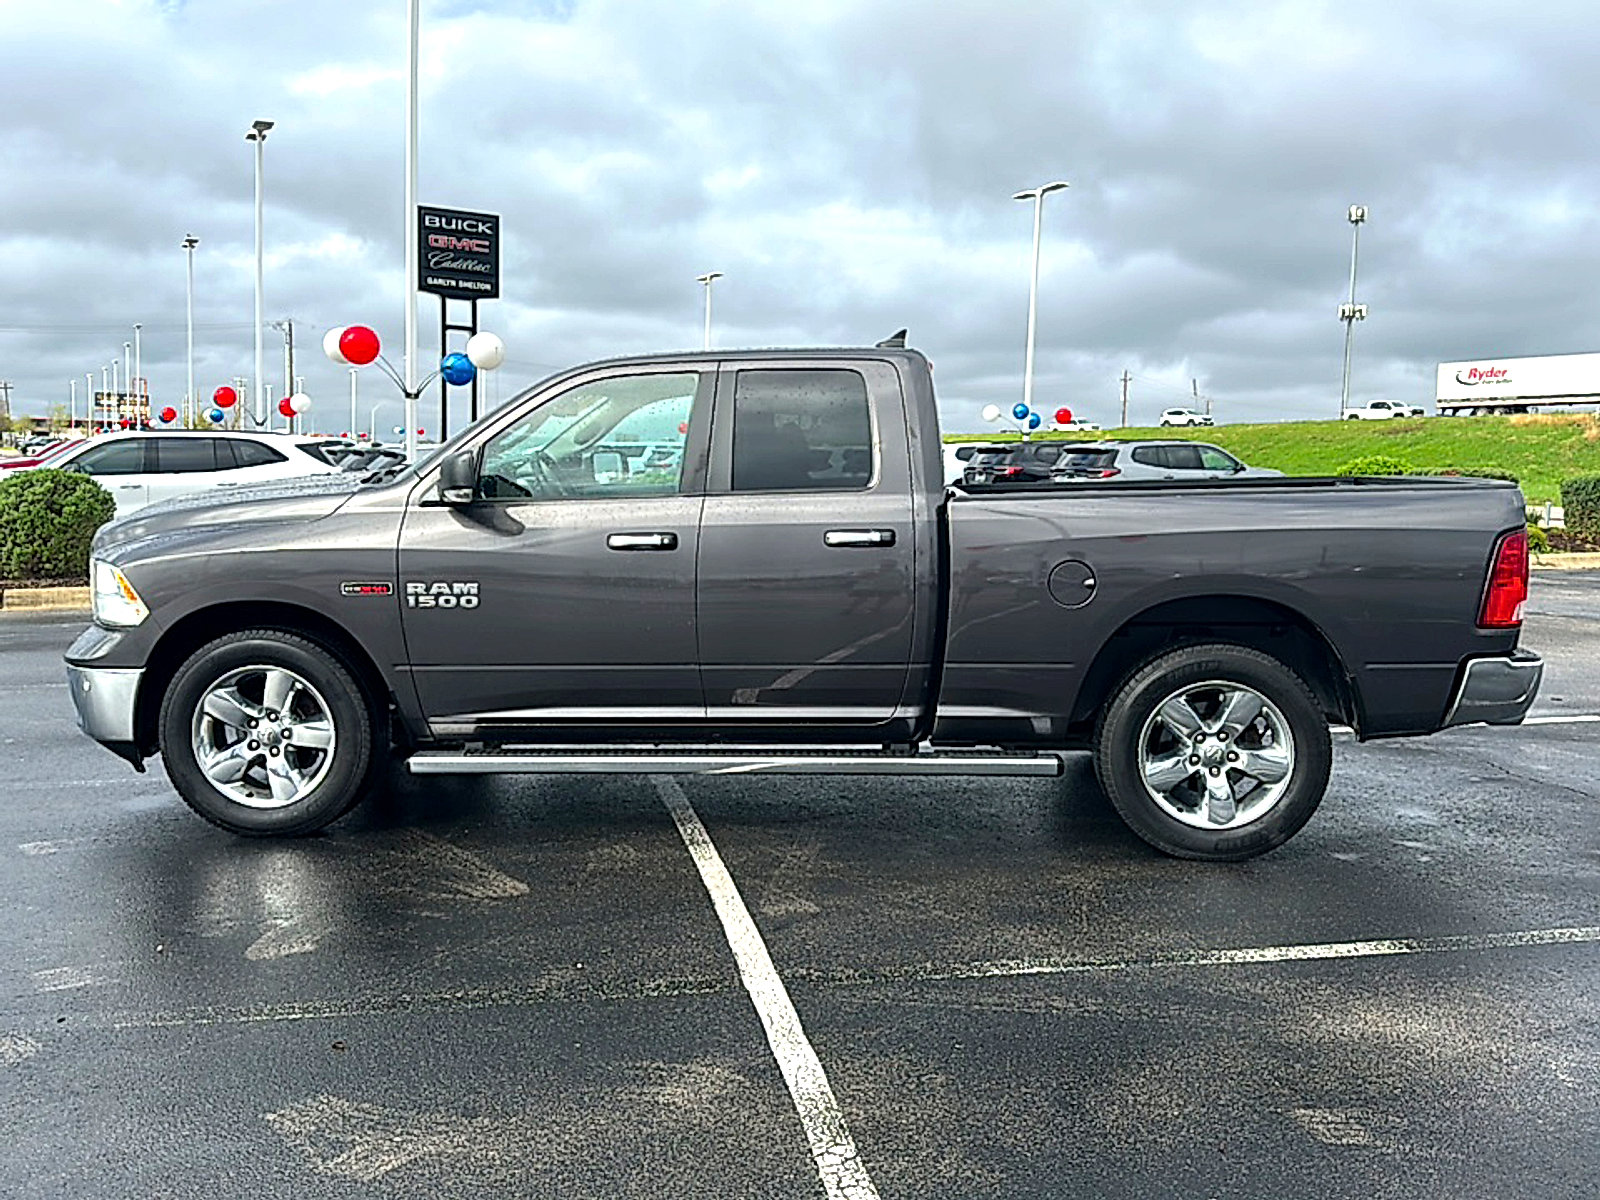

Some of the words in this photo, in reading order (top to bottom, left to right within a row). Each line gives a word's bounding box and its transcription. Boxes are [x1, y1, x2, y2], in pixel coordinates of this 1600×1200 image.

[424, 214, 494, 235] BUICK
[428, 233, 490, 253] GMC
[427, 250, 491, 273] Cadillac
[1467, 366, 1508, 381] Ryder
[406, 582, 479, 595] RAM
[406, 595, 479, 608] 1500
